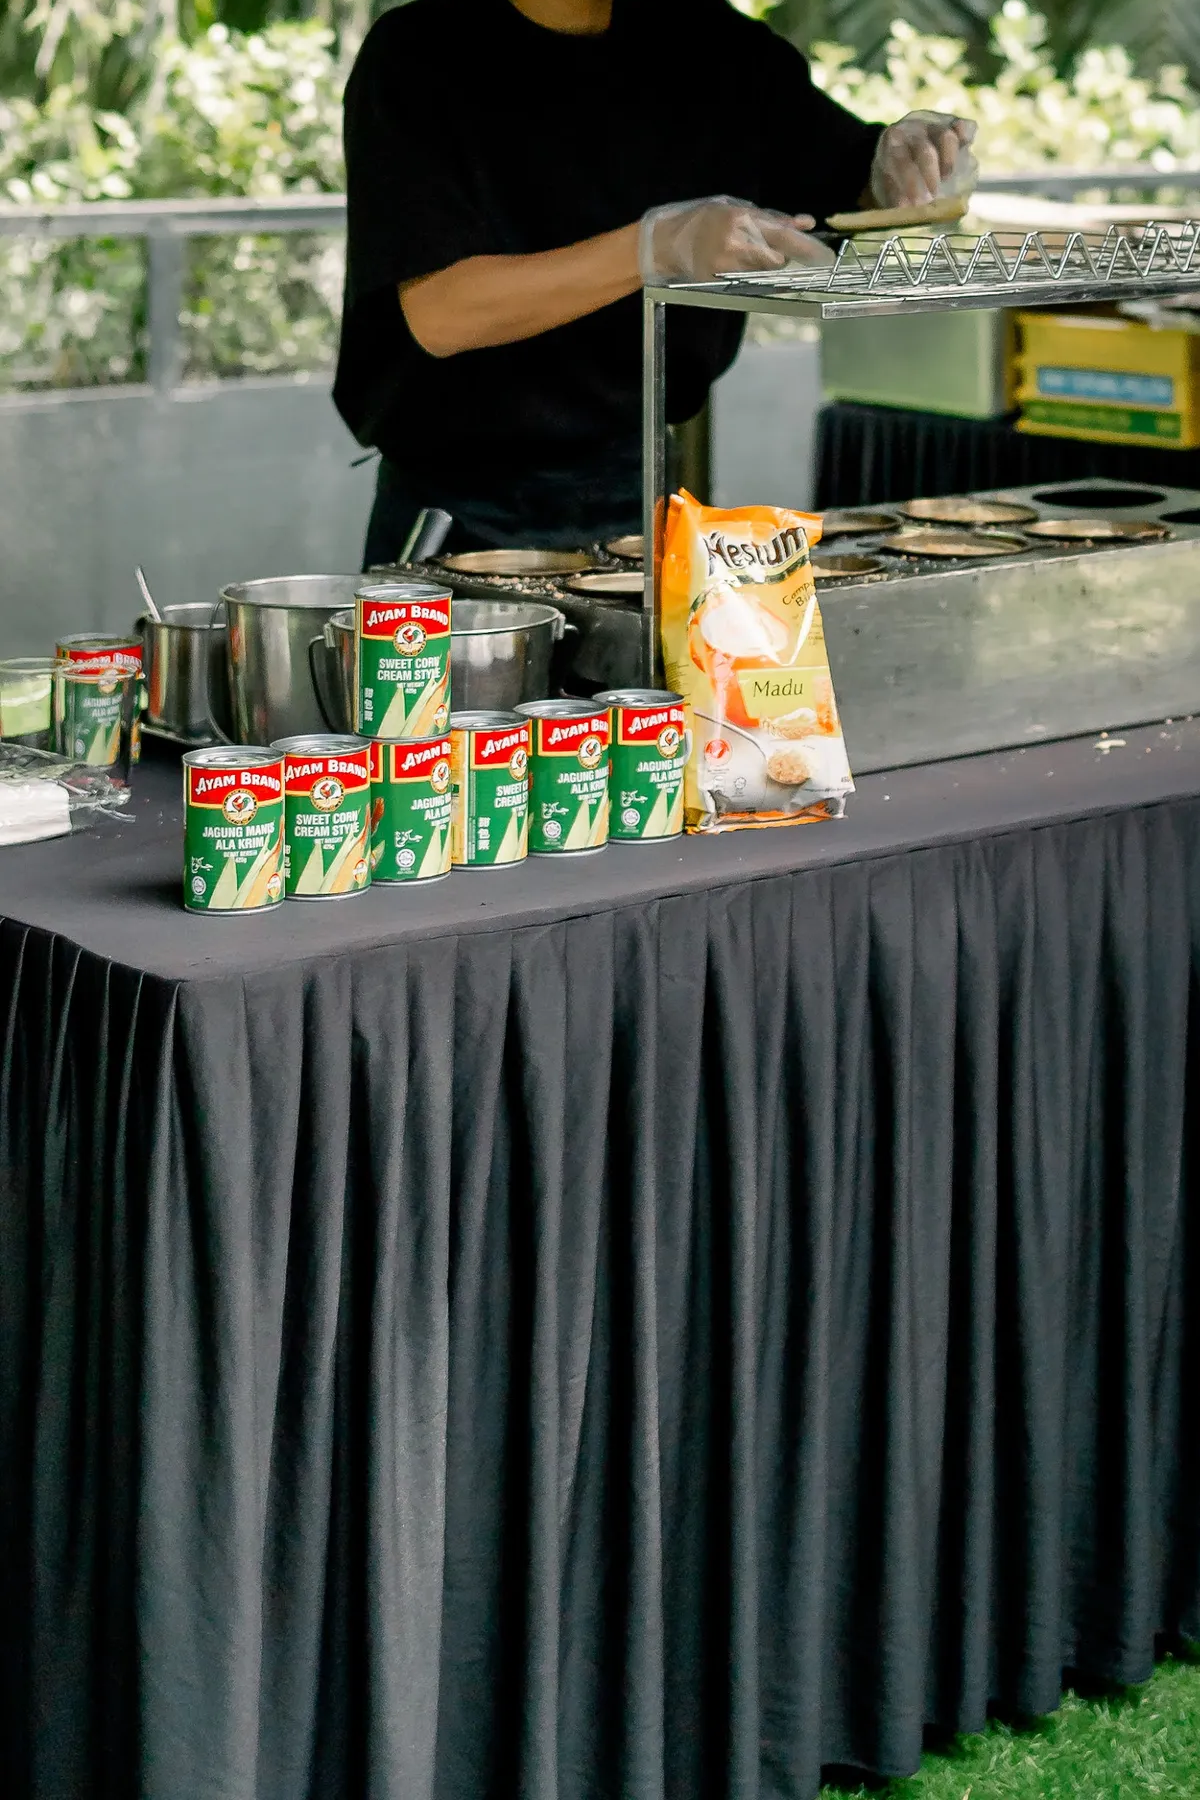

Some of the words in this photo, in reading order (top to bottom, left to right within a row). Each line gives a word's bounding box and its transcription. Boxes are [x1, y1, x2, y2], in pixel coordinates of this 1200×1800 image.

[366, 607, 406, 627] AYAM
[411, 605, 448, 626] BRAND
[379, 658, 413, 669] SWEET
[415, 656, 440, 669] CORN
[377, 670, 412, 681] CREAM
[414, 667, 441, 680] STYLE
[753, 679, 804, 697] Madu
[628, 712, 668, 735] AYAM
[548, 722, 589, 745] AYAM
[481, 733, 519, 758] AYAM
[285, 762, 323, 782] AYAM
[328, 759, 367, 778] BRAND
[636, 760, 672, 773] JAGUNG
[195, 774, 235, 795] AYAM
[241, 771, 280, 791] BRAND
[557, 770, 594, 784] JAGUNG
[649, 772, 667, 783] ALA
[570, 783, 589, 794] ALA
[296, 814, 330, 825] SWEET
[333, 810, 358, 822] CORN
[202, 826, 243, 838] JAGUNG
[246, 822, 275, 836] MANIS
[294, 825, 330, 837] CREAM
[332, 821, 359, 835] STYLE
[215, 838, 236, 850] ALA
[238, 836, 264, 849] KRIM
